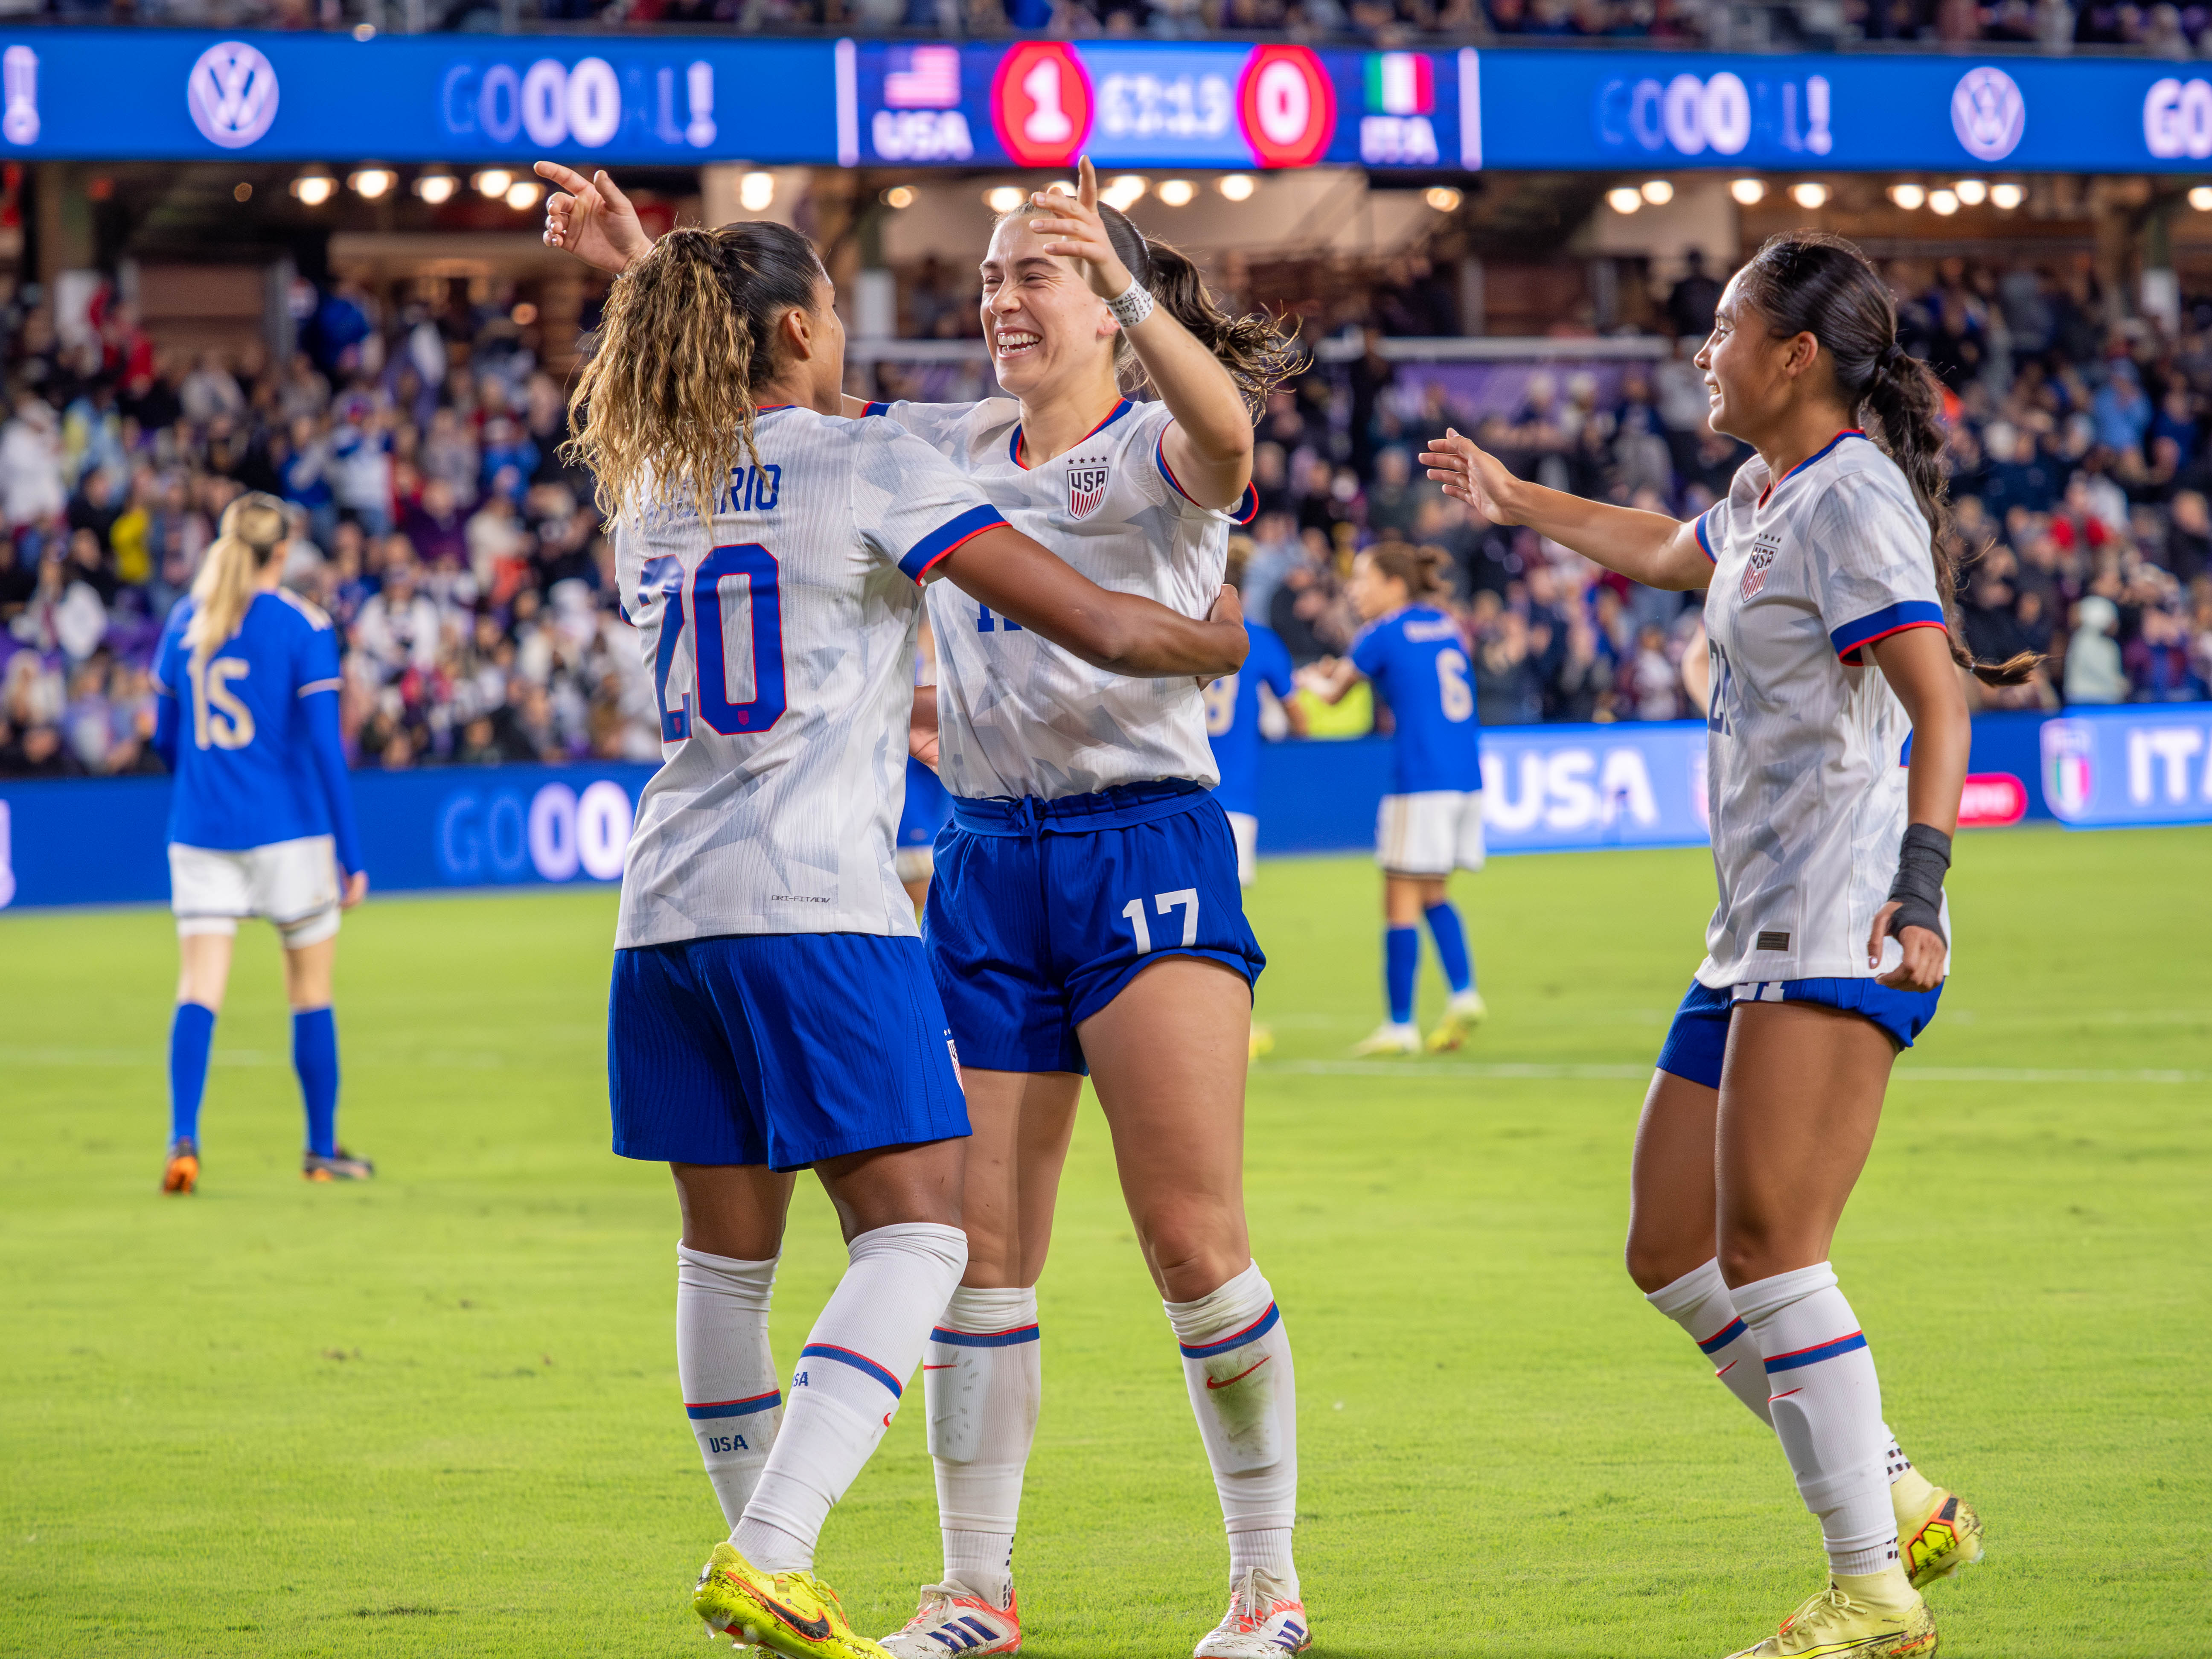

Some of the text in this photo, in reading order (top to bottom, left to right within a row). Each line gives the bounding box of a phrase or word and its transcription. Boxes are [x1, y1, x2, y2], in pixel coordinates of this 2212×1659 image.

[873, 110, 974, 160] USA
[1024, 56, 1073, 144] 1
[1255, 59, 1311, 146] 0
[1071, 470, 1106, 493] USA
[1752, 547, 1775, 570] USA
[637, 542, 787, 743] 20
[186, 656, 256, 751] 15
[1435, 647, 1474, 723] 6
[1479, 748, 1661, 833] USA
[2126, 726, 2212, 806] IT
[1122, 888, 1199, 955] 17
[792, 1371, 808, 1388] SA
[709, 1434, 749, 1453] USA
